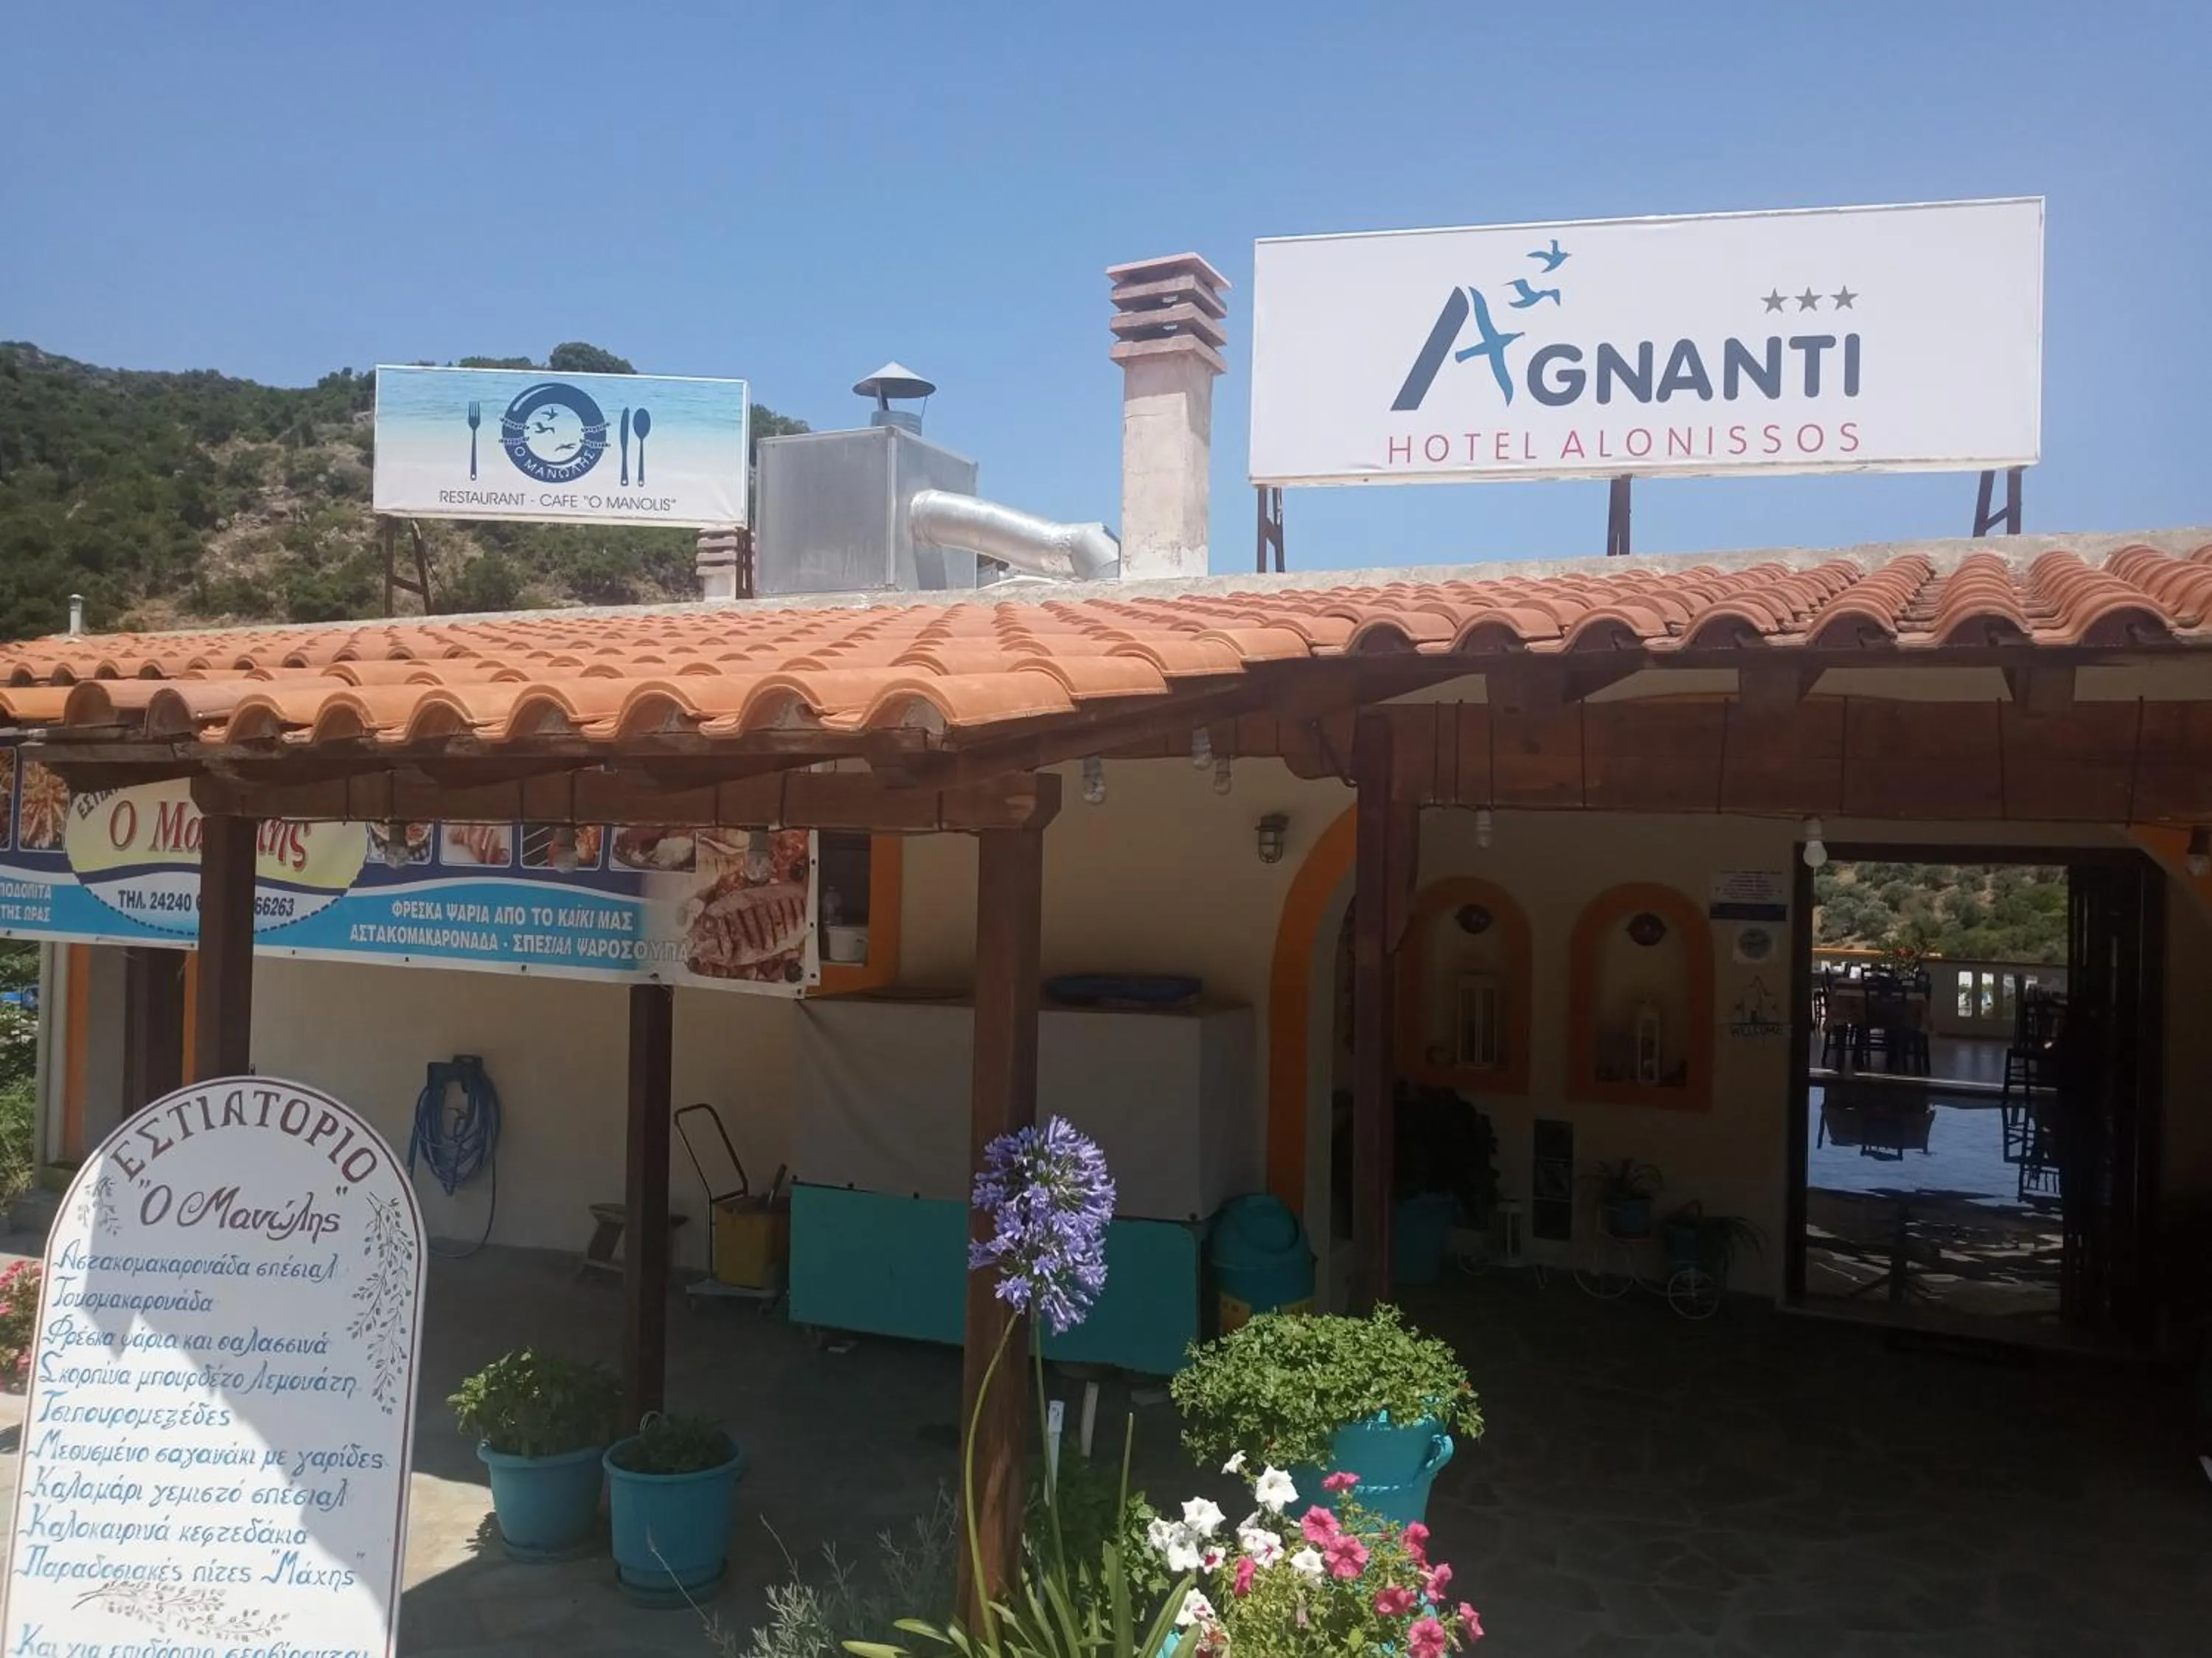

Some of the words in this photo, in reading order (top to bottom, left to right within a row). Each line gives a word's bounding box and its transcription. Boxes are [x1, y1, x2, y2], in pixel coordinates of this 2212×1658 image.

[1389, 285, 1860, 412] AGNANTI
[1388, 431, 1538, 465] HOTEL
[1559, 422, 1860, 460] ALONISSOS
[524, 450, 595, 479] ΜΑΝΩΛΗΣ
[439, 490, 526, 507] RESTAURANT
[540, 493, 578, 508] CAFE
[606, 496, 677, 512] MANOLIS"
[150, 891, 192, 912] 24240
[392, 899, 442, 920] ΦΡΕΣΚΑ
[446, 902, 490, 923] ΨΑΡΙΑ
[493, 906, 526, 926] ΑΠΟ
[531, 907, 553, 926] ΤΟ
[597, 910, 634, 931] ΜΑΣ
[349, 924, 498, 951] ΑΣΤΑΚΟΜΑΚΑΡΟΝΑΔΑ
[512, 934, 571, 955] ΣΠΕΣΙΑΛ
[577, 937, 689, 962] ΨΑΡΟΣΟΥΠΑ
[109, 1089, 378, 1184] ΕΣΤΙΑΤΟΡΙΟ
[52, 1238, 250, 1280] Αστακομακαρονάδα
[43, 1314, 114, 1350] Φρέσκα
[259, 1449, 288, 1472] με
[291, 1443, 383, 1477] γαρίδες
[23, 1465, 143, 1505] Καλαμάρι
